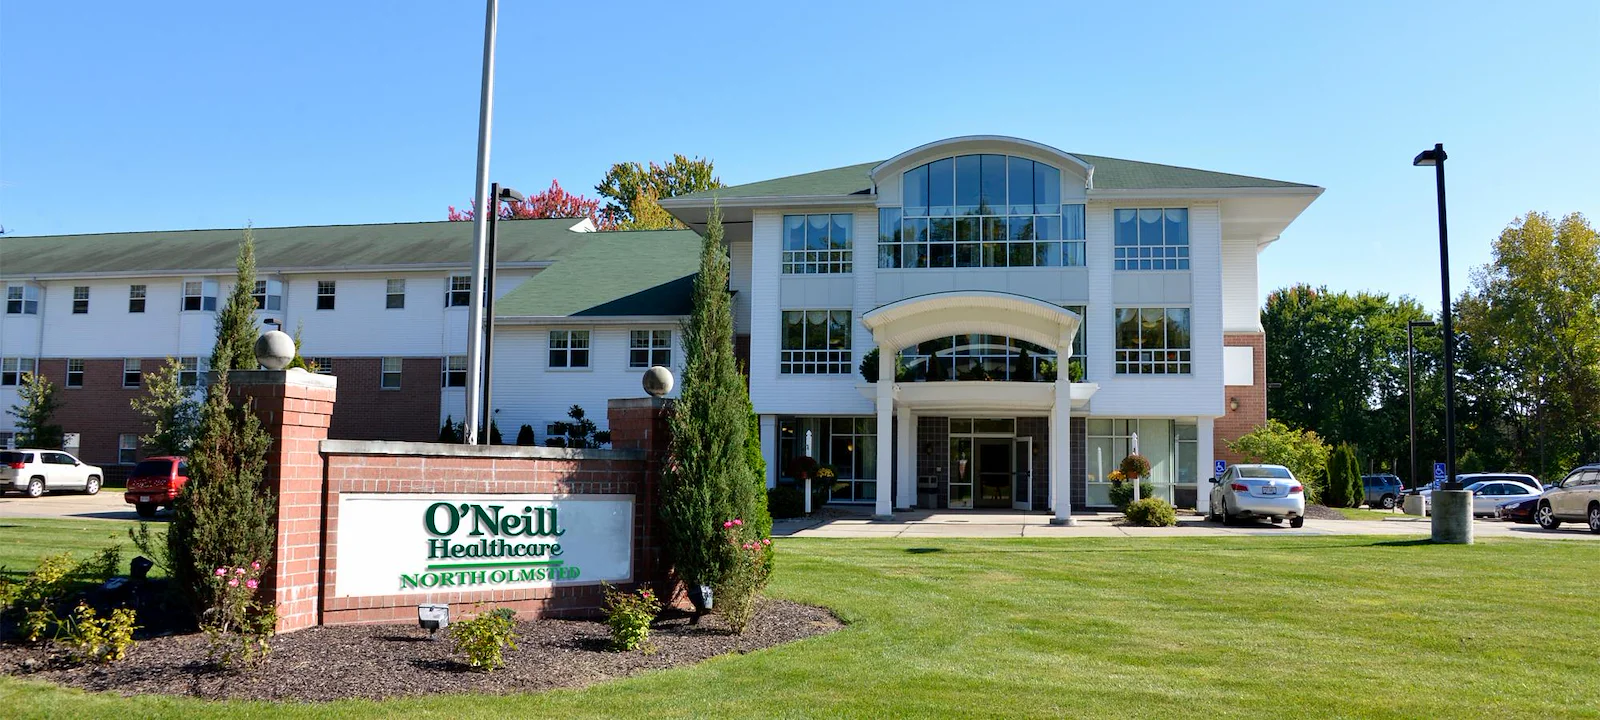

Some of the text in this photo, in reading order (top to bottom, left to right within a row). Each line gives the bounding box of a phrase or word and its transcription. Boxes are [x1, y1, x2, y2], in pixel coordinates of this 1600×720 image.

[425, 502, 565, 537] O'Neill
[427, 538, 564, 559] Healthcare
[400, 566, 581, 588] NORTH OLMSTED
